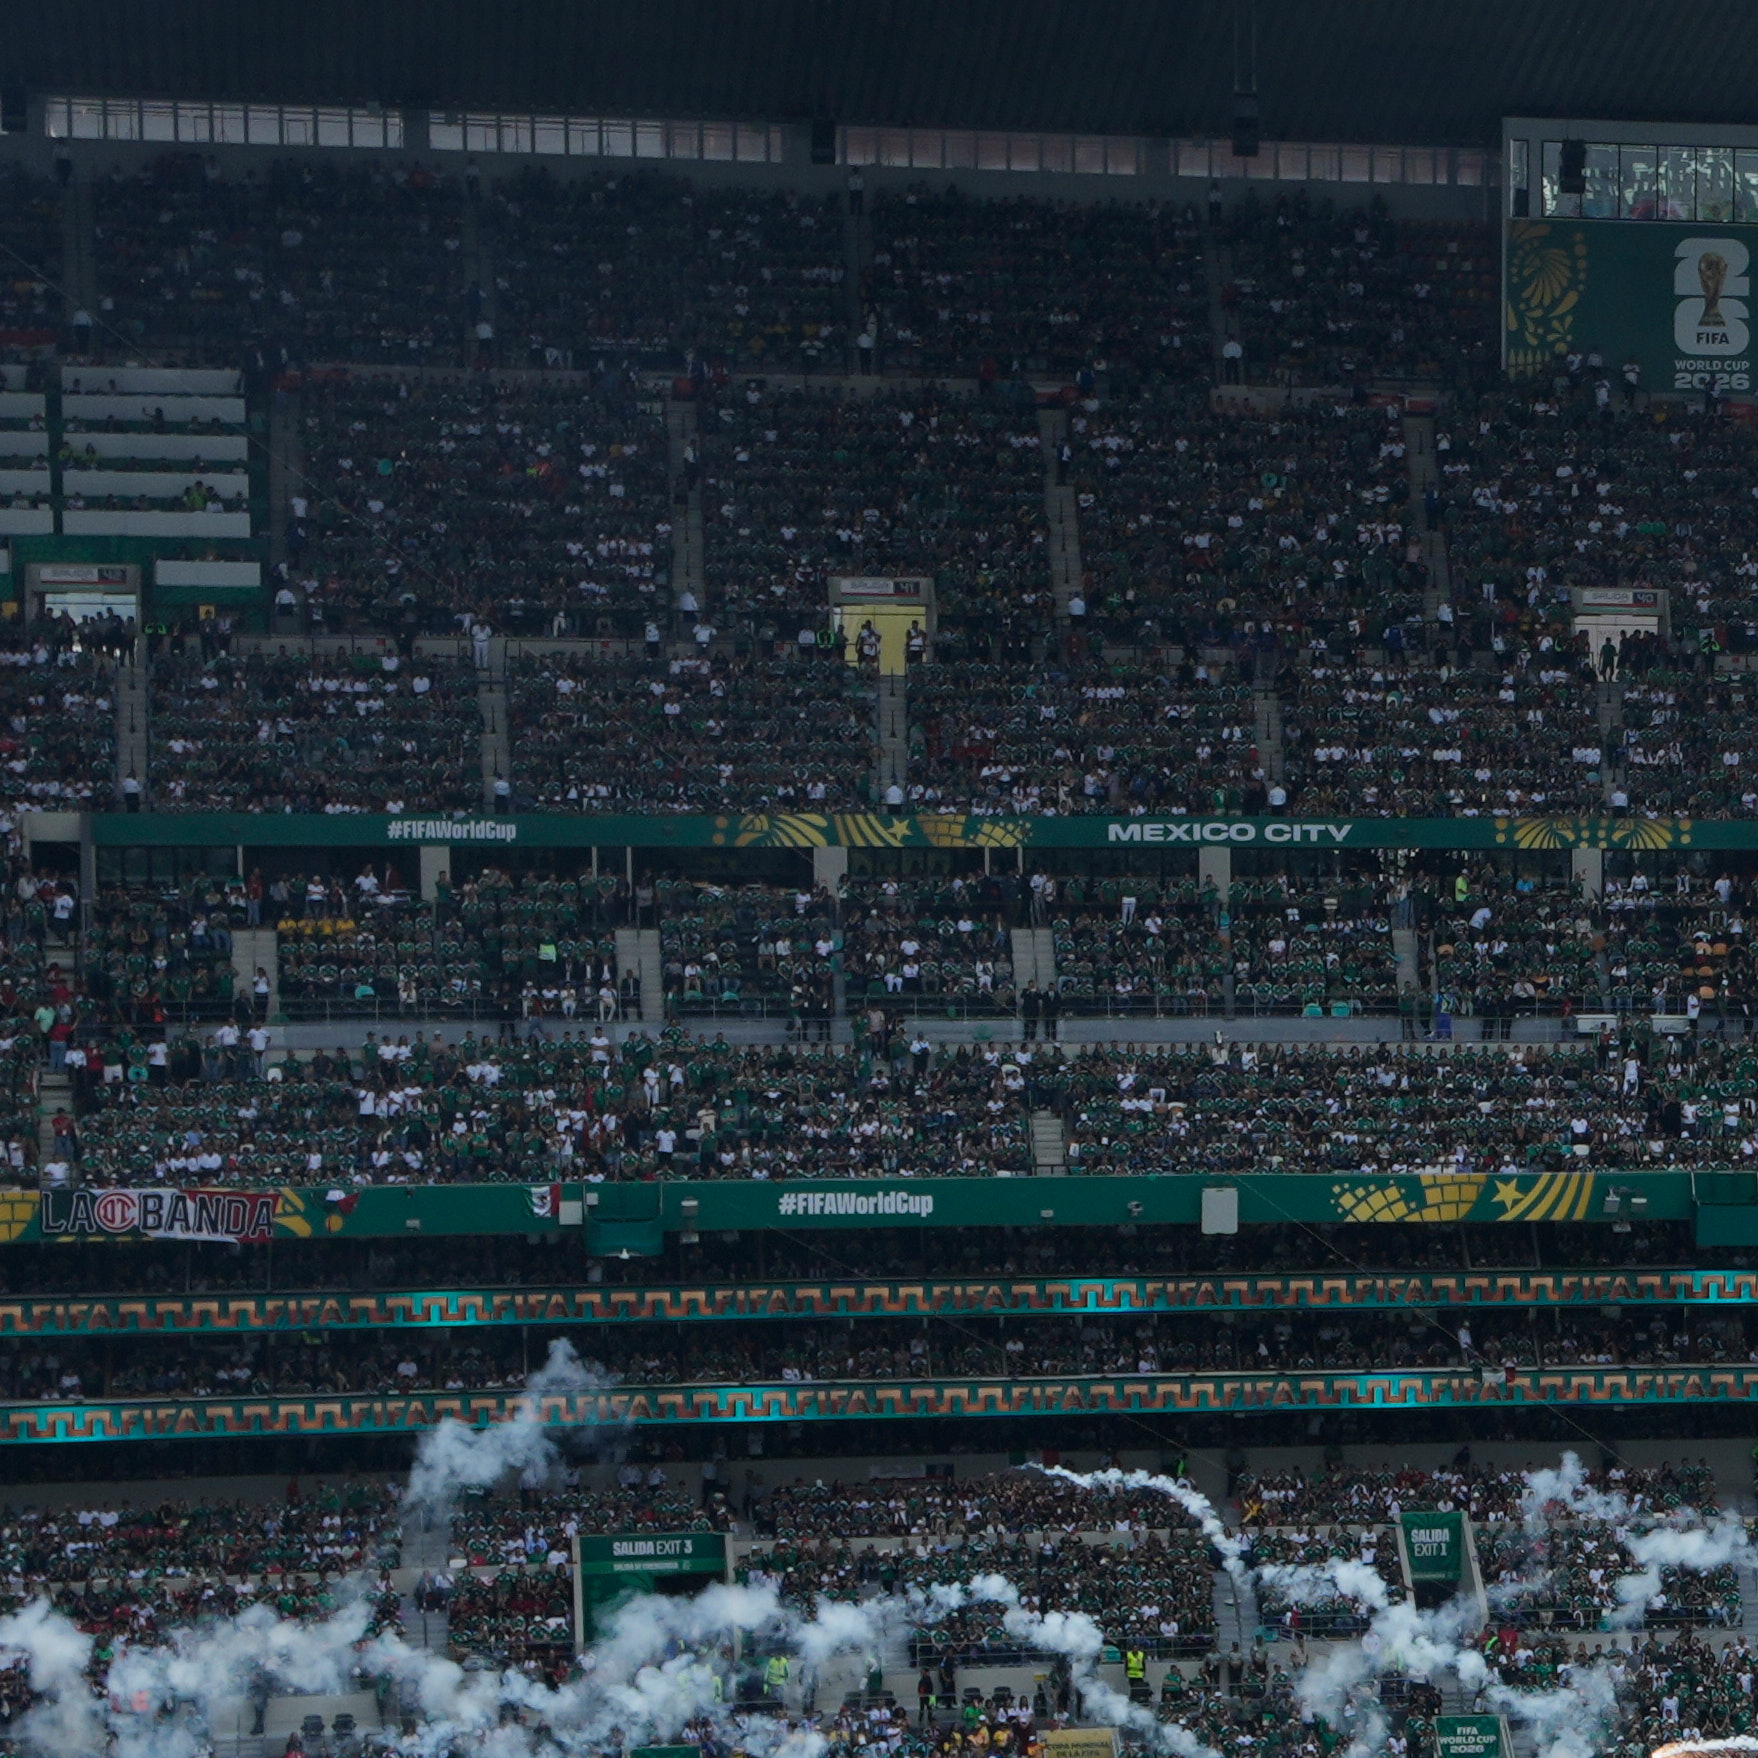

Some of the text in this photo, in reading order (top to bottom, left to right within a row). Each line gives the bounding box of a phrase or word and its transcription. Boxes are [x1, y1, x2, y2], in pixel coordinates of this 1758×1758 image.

[1696, 333, 1729, 345] FIFA
[1675, 360, 1750, 371] WORLD CUP
[1674, 372, 1750, 390] 2026
[387, 820, 516, 842] #FIFAWorldCup
[1108, 823, 1352, 843] MEXICO CITY
[778, 1191, 934, 1218] #FIFAWorldCup
[41, 1193, 273, 1238] LA BANDA
[33, 1302, 112, 1330] FIFA
[273, 1299, 346, 1326] FIFA
[495, 1294, 570, 1322] FIFA
[716, 1289, 789, 1315] FIFA
[933, 1285, 1006, 1312] FIFA
[1147, 1281, 1216, 1308] FIFA
[1355, 1279, 1425, 1305] FIFA
[1564, 1276, 1635, 1301] FIFA
[122, 1407, 197, 1436] FIFA
[352, 1402, 425, 1430] FIFA
[800, 1389, 875, 1416] FIFA
[1012, 1385, 1085, 1411] FIFA
[1226, 1382, 1296, 1407] FIFA
[1637, 1375, 1703, 1400] FIFA
[1411, 1528, 1450, 1543] SALIDA
[613, 1540, 692, 1556] SALIDA EXIT 3
[1415, 1542, 1447, 1557] EXIT 1
[1456, 1725, 1479, 1735] FIFA
[1440, 1735, 1497, 1745] WORLD CUP
[1450, 1745, 1485, 1754] 2026
